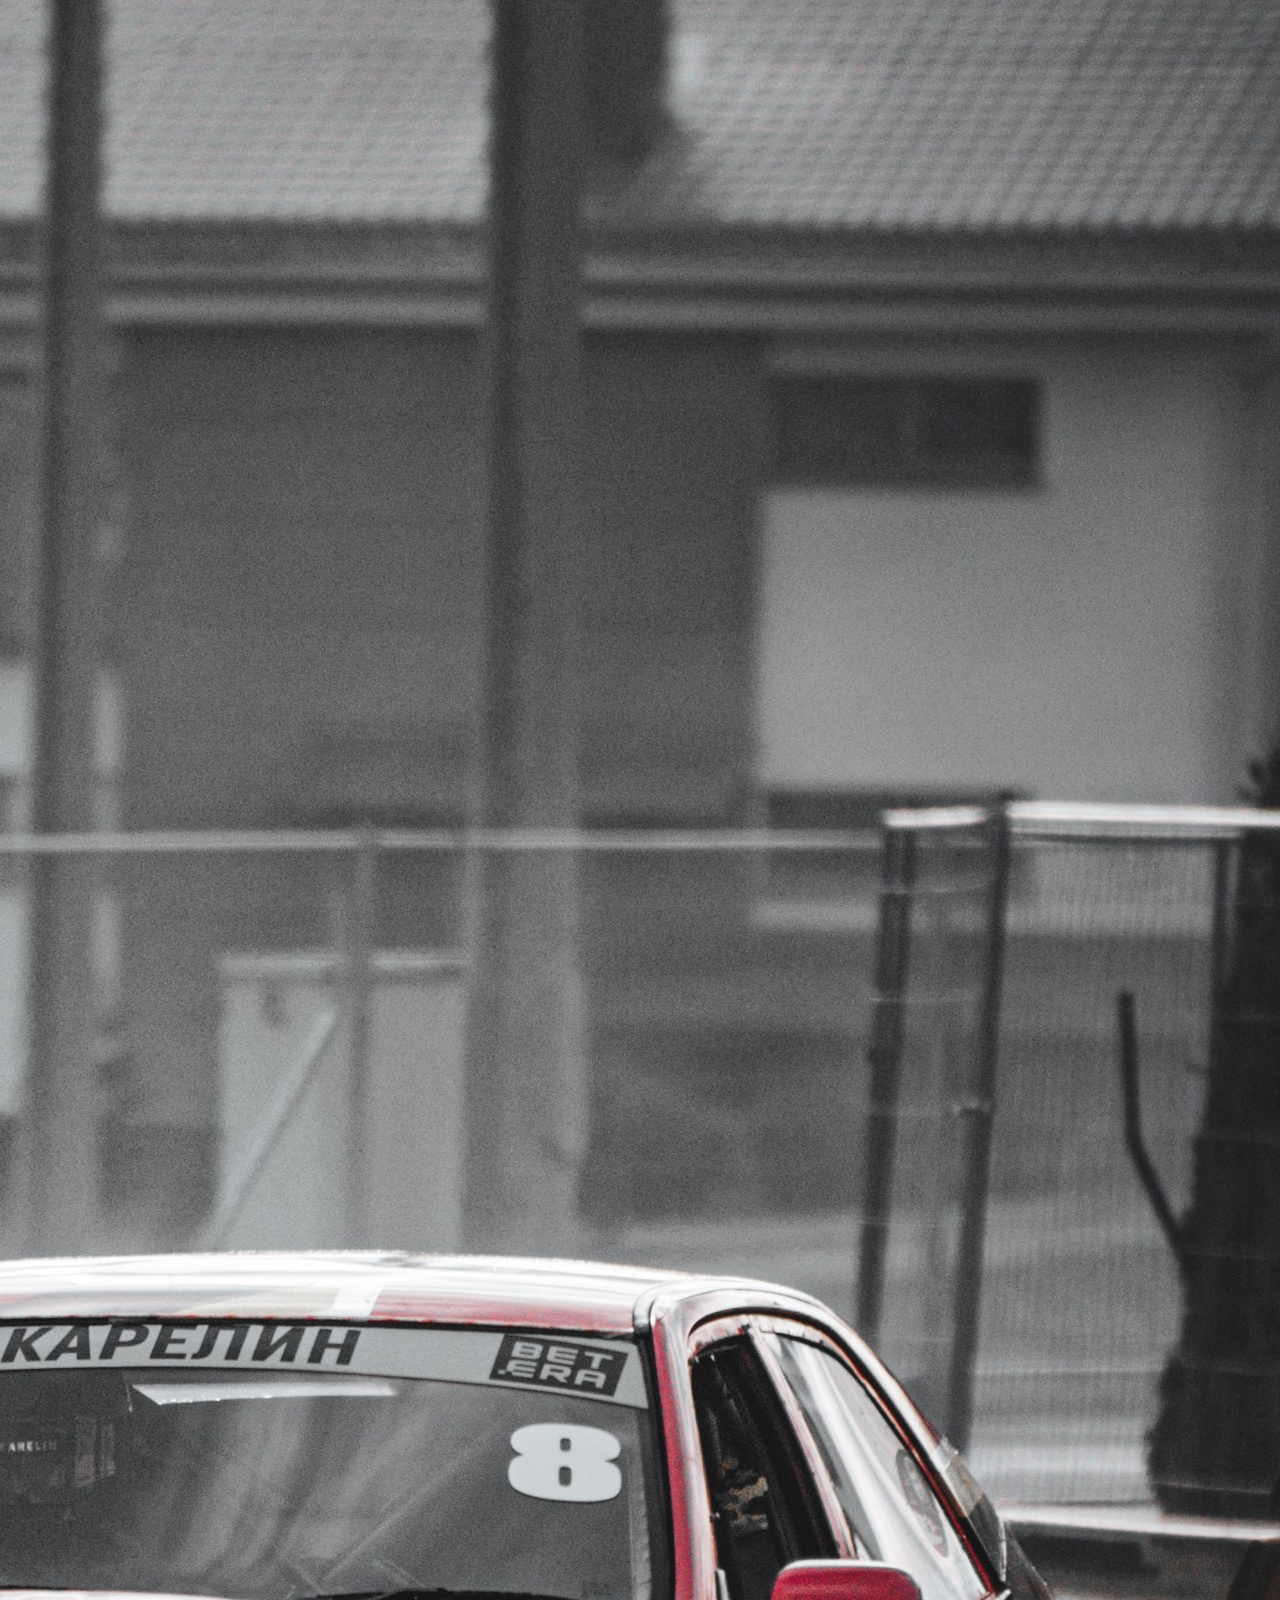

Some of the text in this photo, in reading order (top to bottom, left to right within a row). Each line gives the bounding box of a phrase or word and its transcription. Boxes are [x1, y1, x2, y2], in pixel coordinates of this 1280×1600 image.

[0, 1325, 361, 1365] КАРЕЛИН
[510, 1341, 613, 1370] BET
[508, 1423, 622, 1503] 8
